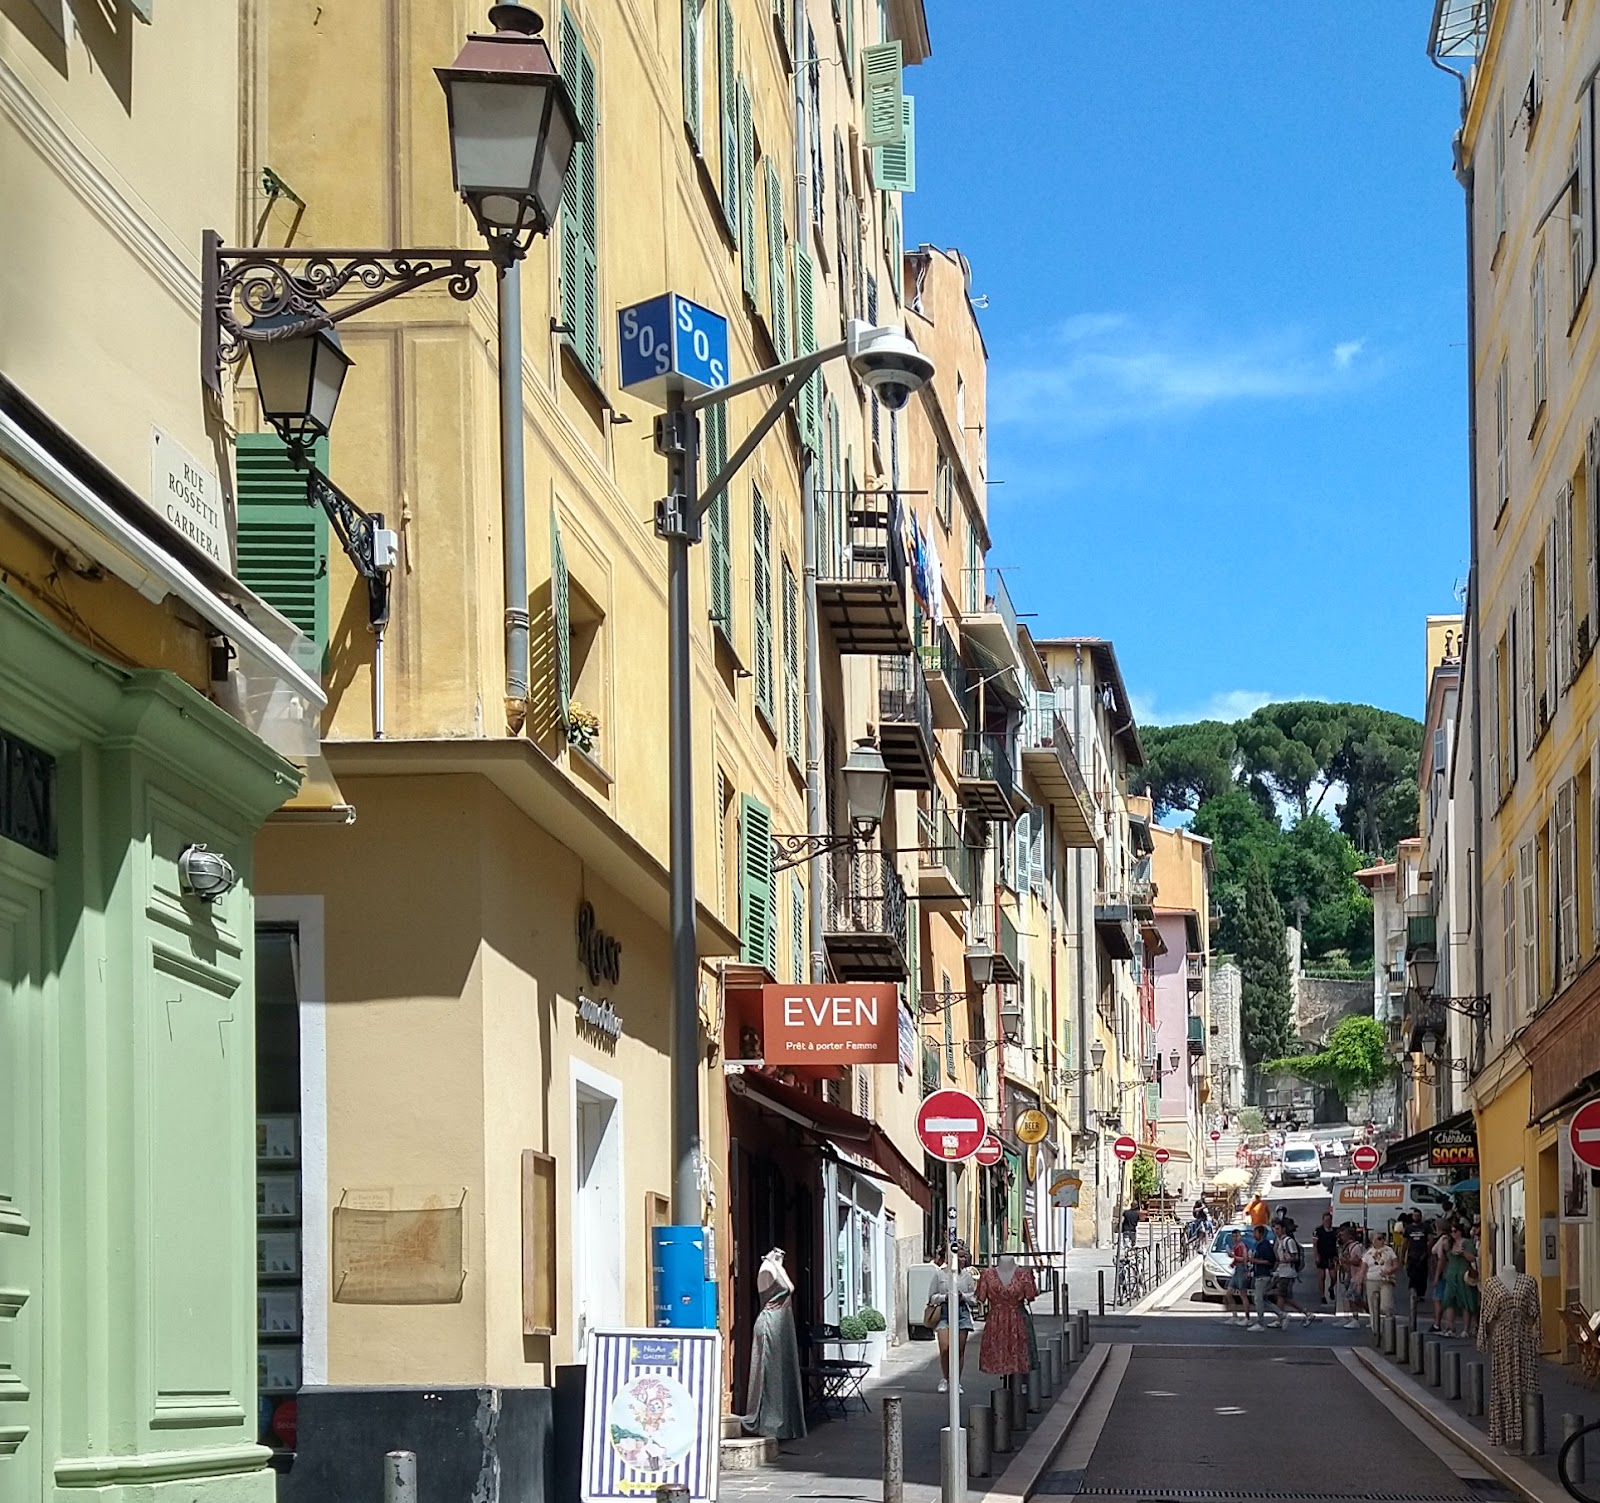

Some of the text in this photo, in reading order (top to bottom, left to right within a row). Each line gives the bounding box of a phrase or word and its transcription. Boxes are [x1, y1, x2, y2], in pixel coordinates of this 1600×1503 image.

[623, 308, 670, 375] SOS
[677, 299, 725, 390] SOS
[183, 462, 204, 495] RUE
[168, 472, 218, 529] ROSSETTI
[166, 504, 220, 560] CARRIERA
[784, 997, 878, 1027] EVEN
[785, 1041, 878, 1052] Prêt à porter Femme
[1024, 1121, 1040, 1130] BEER
[1432, 1147, 1476, 1163] SOCCA
